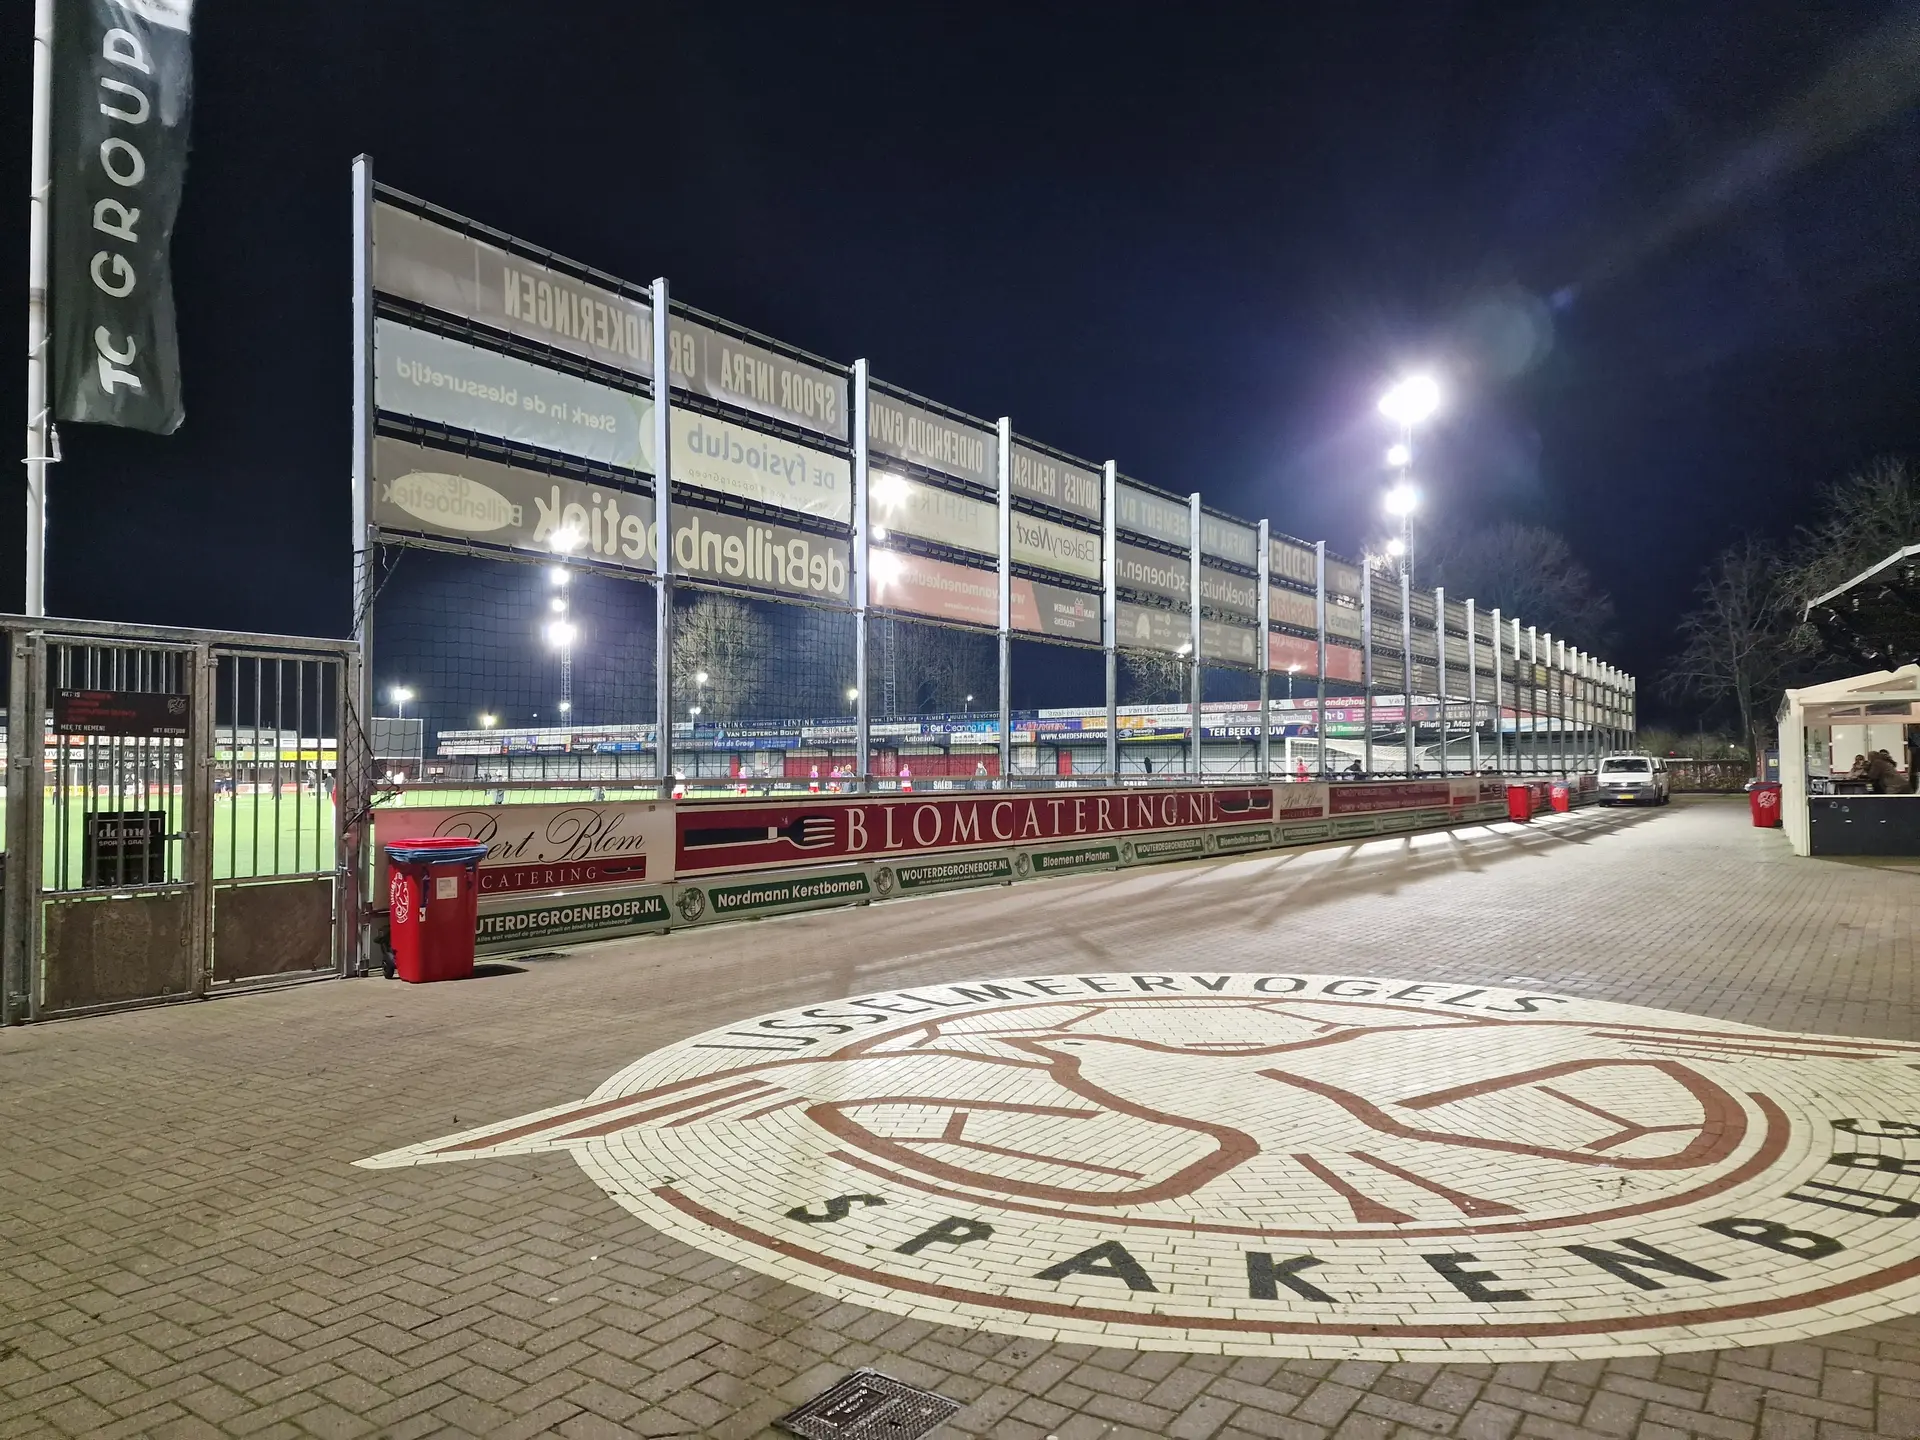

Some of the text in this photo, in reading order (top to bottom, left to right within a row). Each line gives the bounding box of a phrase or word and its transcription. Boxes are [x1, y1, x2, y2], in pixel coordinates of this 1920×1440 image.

[90, 27, 154, 298] GROUP
[1156, 705, 1179, 713] Geest
[714, 721, 744, 729] LENTINK
[784, 718, 815, 727] LENTINK
[1209, 726, 1286, 737] TER BEEK BUW
[735, 740, 755, 748] Groep
[845, 790, 1219, 852] BLOMCATERING.NL
[538, 808, 646, 862] Blom
[1043, 850, 1110, 868] Bloemen en Planten
[481, 867, 597, 890] CATERING
[901, 860, 1008, 881] WOUTERDEGROENEBOER.NL
[718, 878, 863, 908] Nordmann Kerstbomen
[475, 898, 662, 935] UTERDEGROENEBOER.NL
[530, 928, 546, 938] grond
[692, 974, 1570, 1052] IJSSELMEERVOGELS
